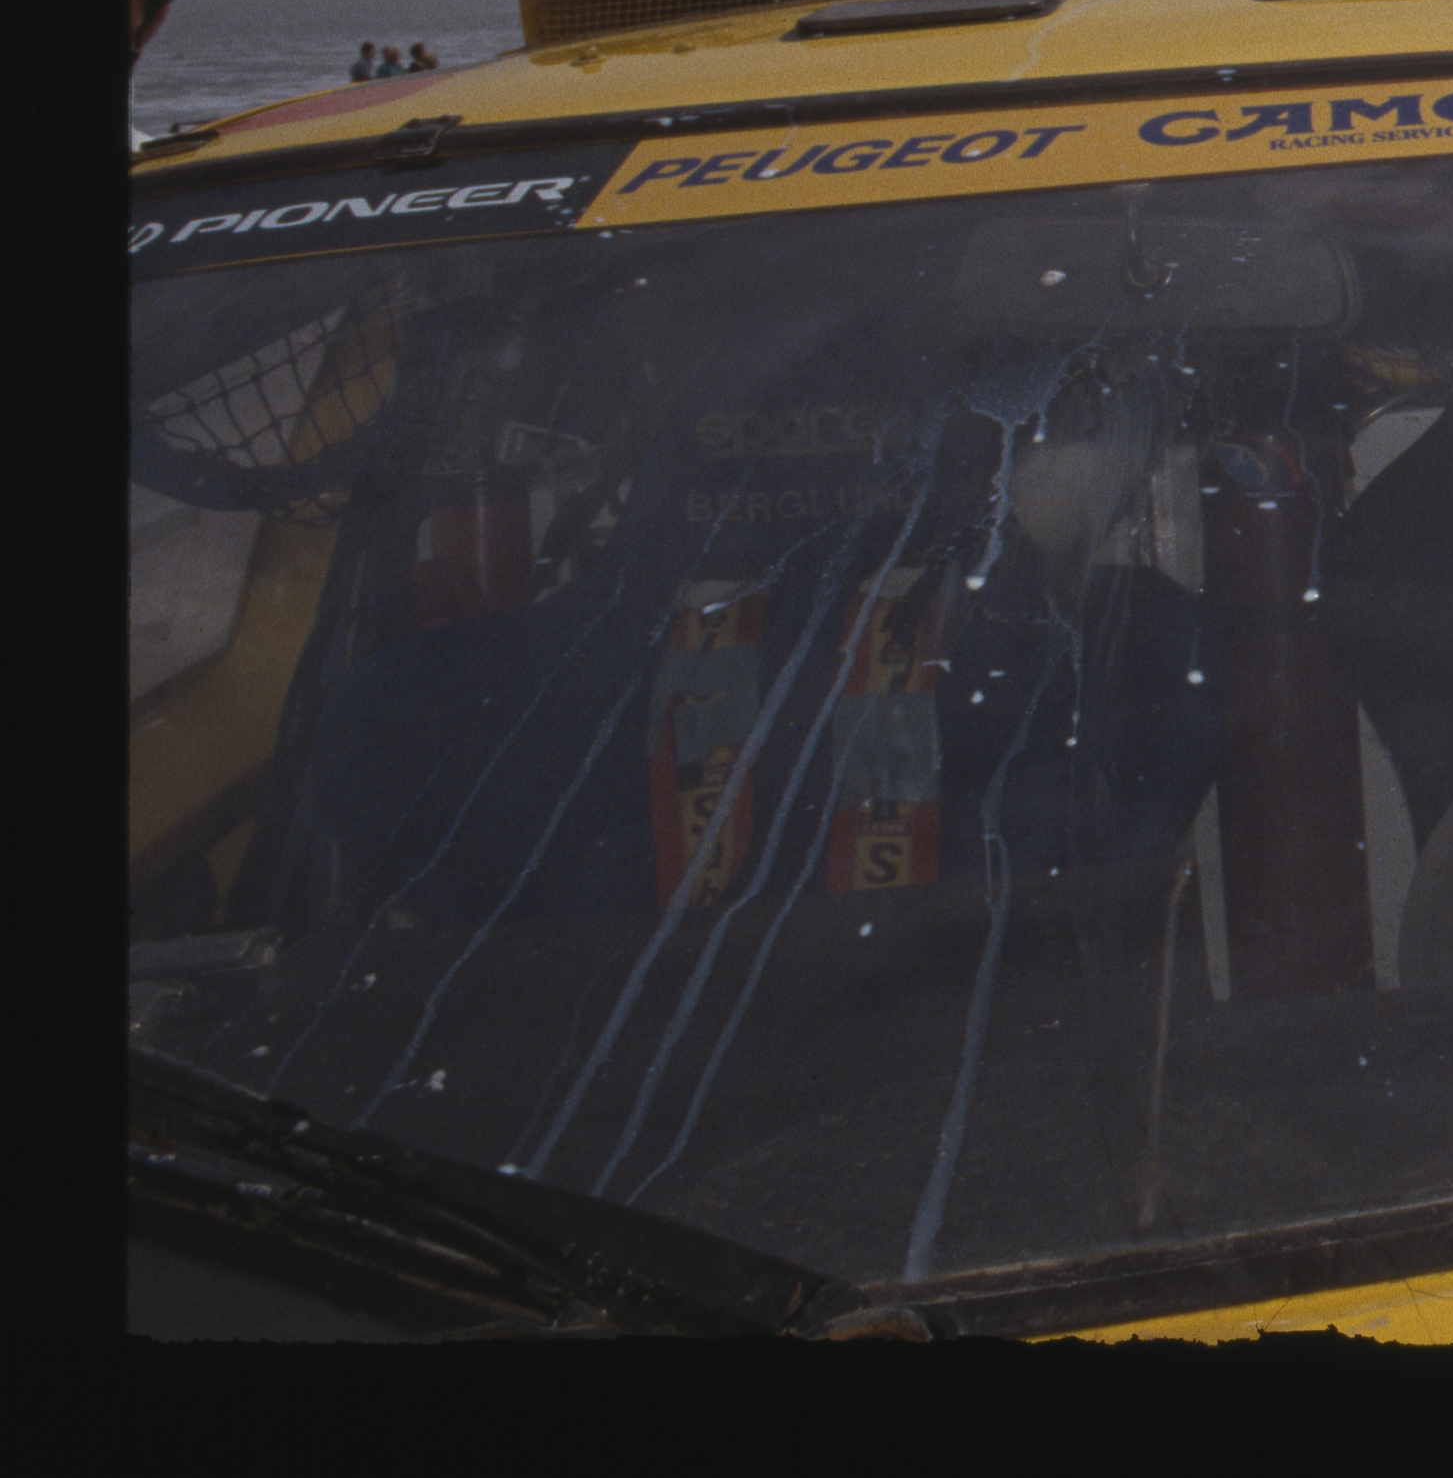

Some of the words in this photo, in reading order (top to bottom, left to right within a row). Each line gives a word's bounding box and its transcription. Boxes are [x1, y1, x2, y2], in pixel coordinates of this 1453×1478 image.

[614, 125, 1087, 195] PEUGEOT
[1268, 132, 1365, 151] RACING
[169, 177, 576, 243] PIONEER
